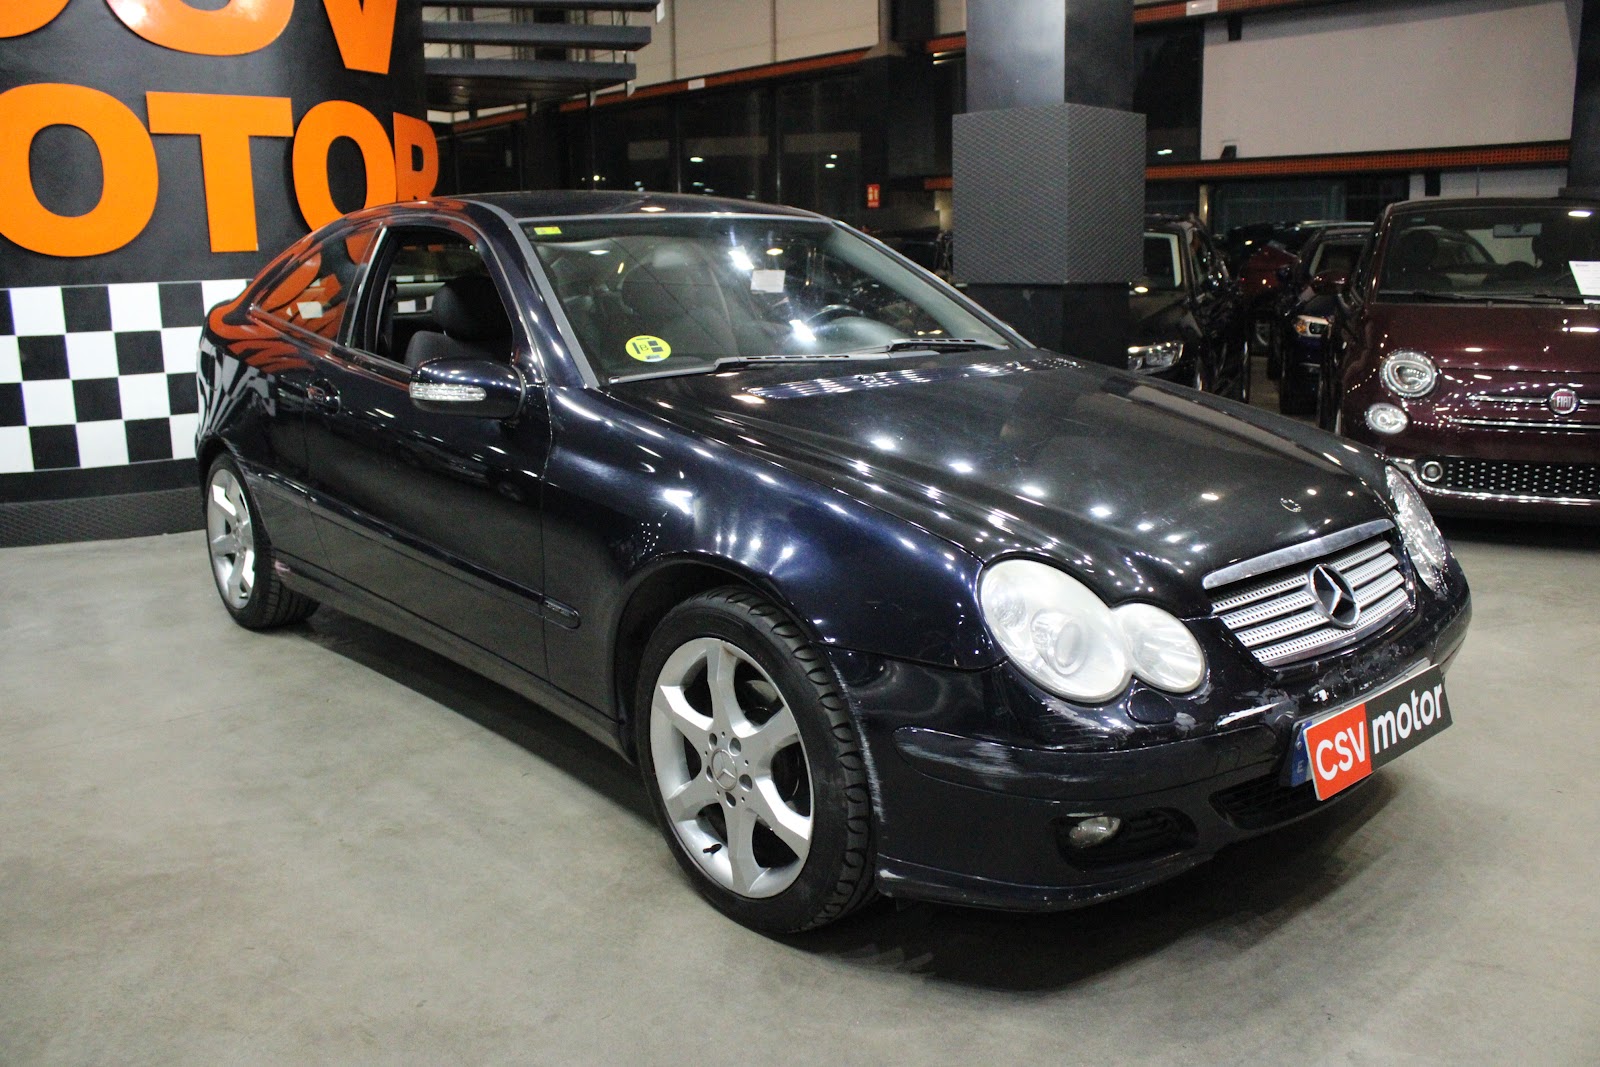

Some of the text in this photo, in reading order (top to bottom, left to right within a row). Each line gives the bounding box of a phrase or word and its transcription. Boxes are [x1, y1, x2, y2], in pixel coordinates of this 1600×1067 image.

[1556, 395, 1573, 408] FIAT
[1315, 683, 1443, 781] CSV motor
